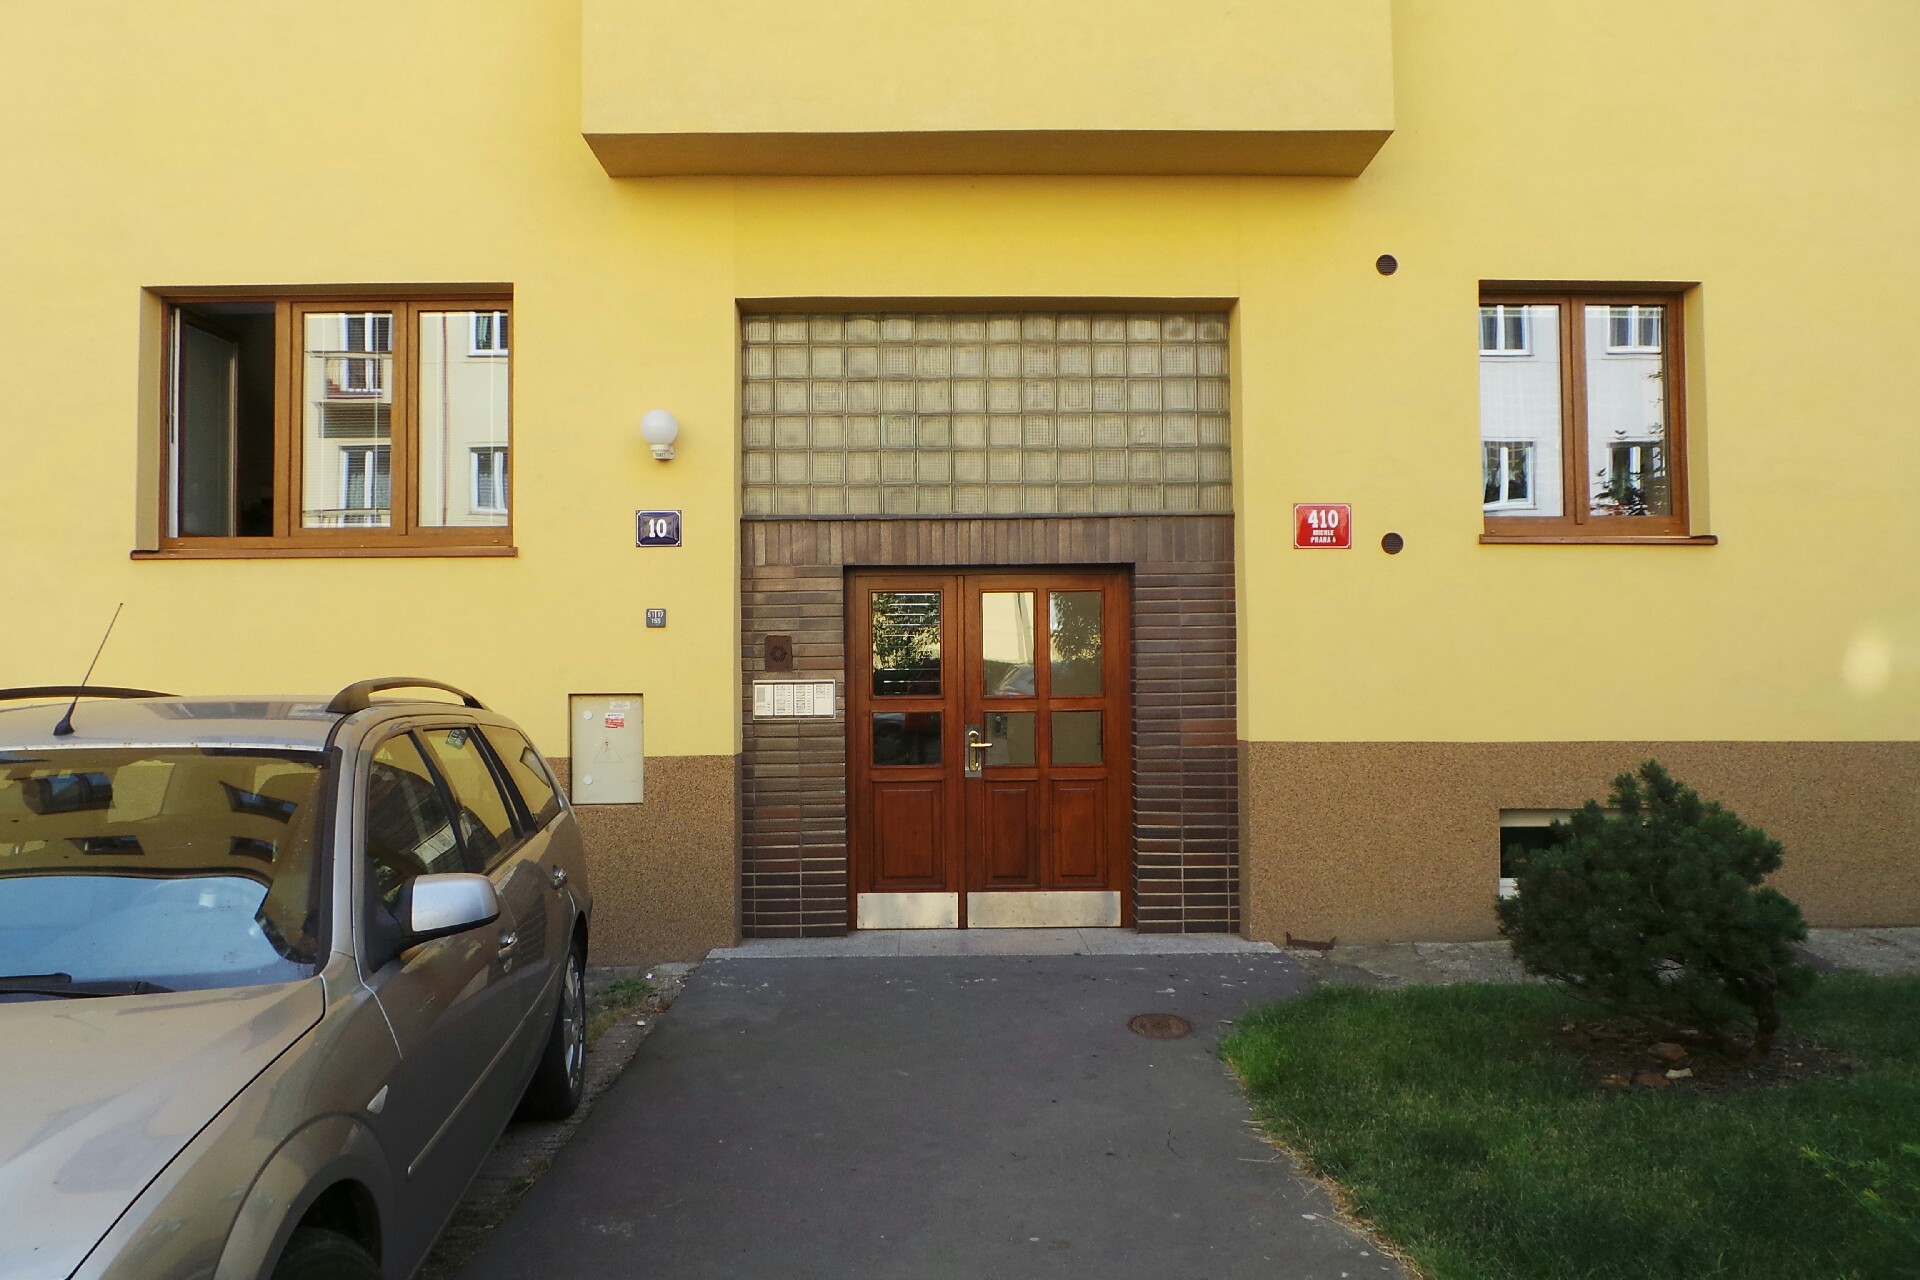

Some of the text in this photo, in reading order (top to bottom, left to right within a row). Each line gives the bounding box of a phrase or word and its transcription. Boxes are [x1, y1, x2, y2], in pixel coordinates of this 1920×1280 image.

[649, 518, 667, 538] 10
[1308, 509, 1339, 528] 410
[1310, 536, 1331, 544] PRAHA
